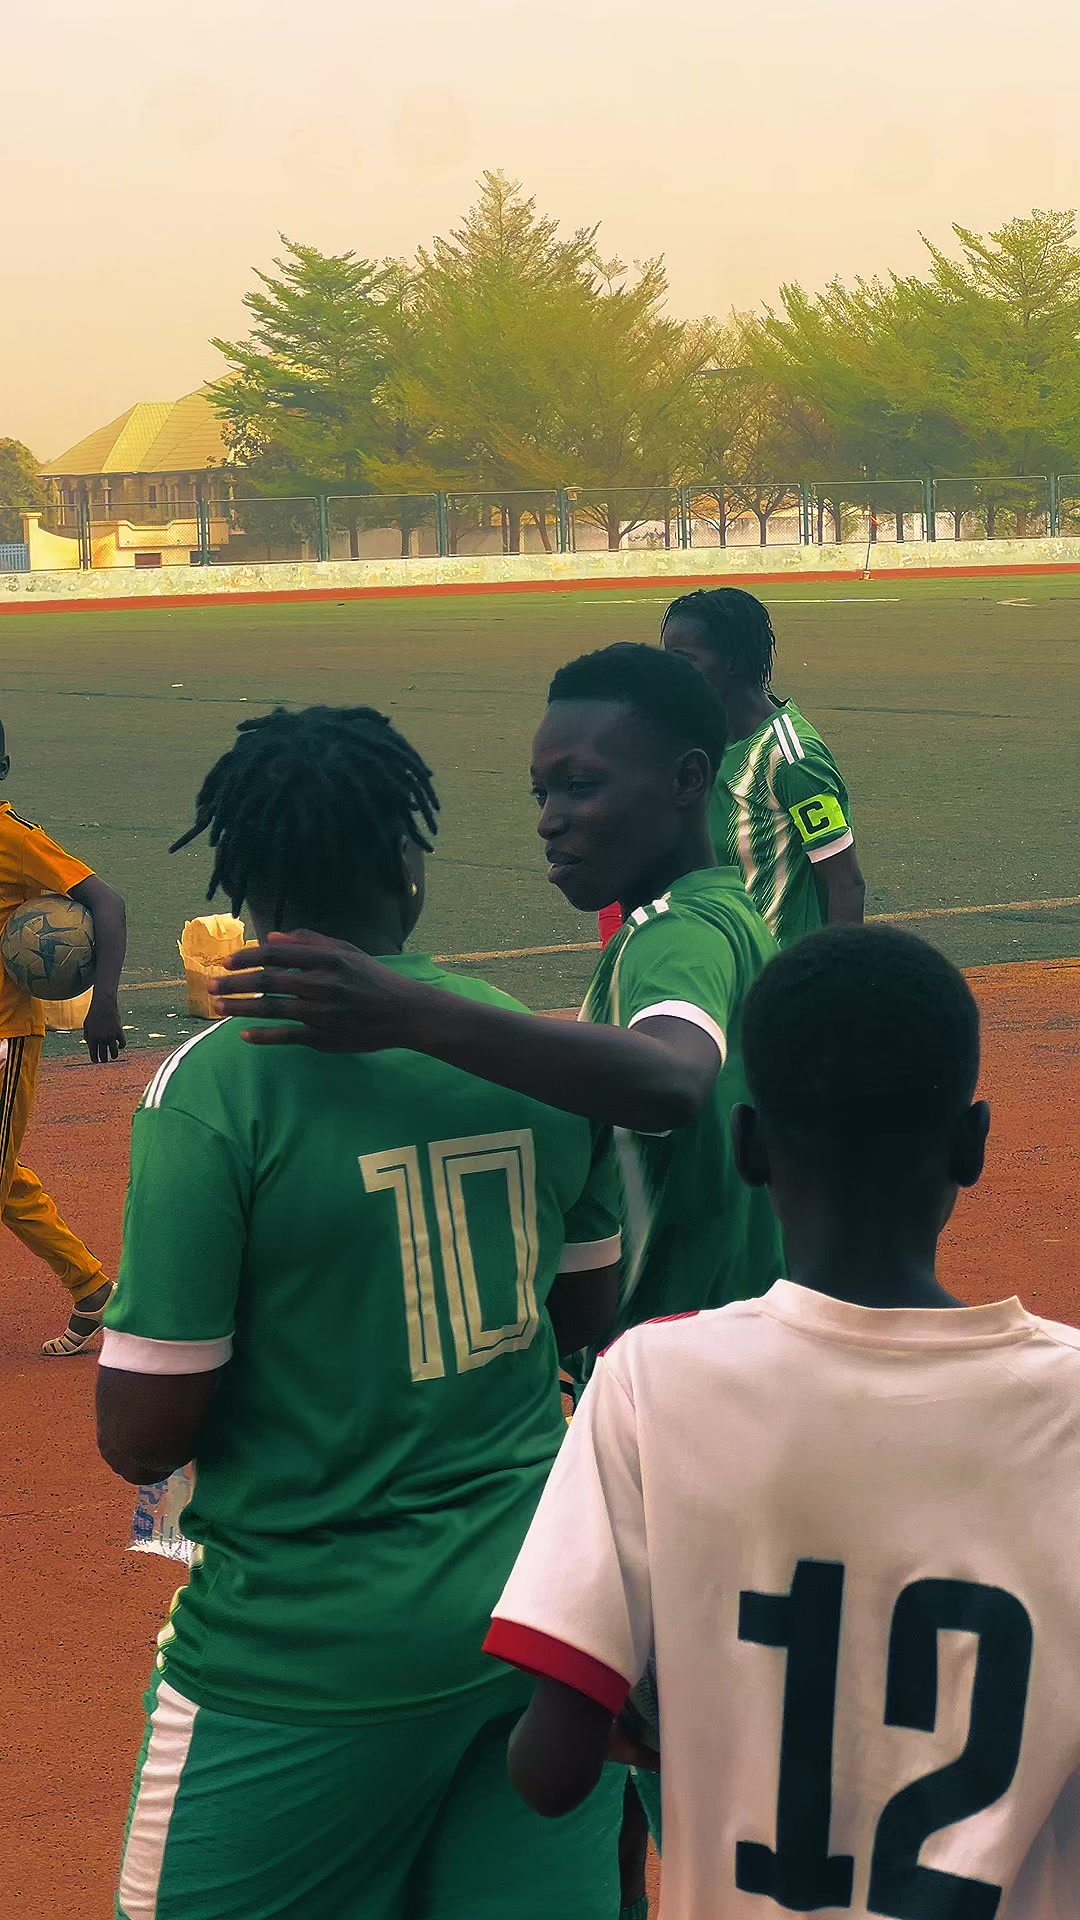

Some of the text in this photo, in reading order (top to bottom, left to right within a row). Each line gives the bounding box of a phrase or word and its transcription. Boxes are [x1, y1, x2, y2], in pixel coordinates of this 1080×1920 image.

[798, 801, 830, 834] C
[358, 1129, 539, 1382] 10
[736, 1560, 1034, 1920] 12
